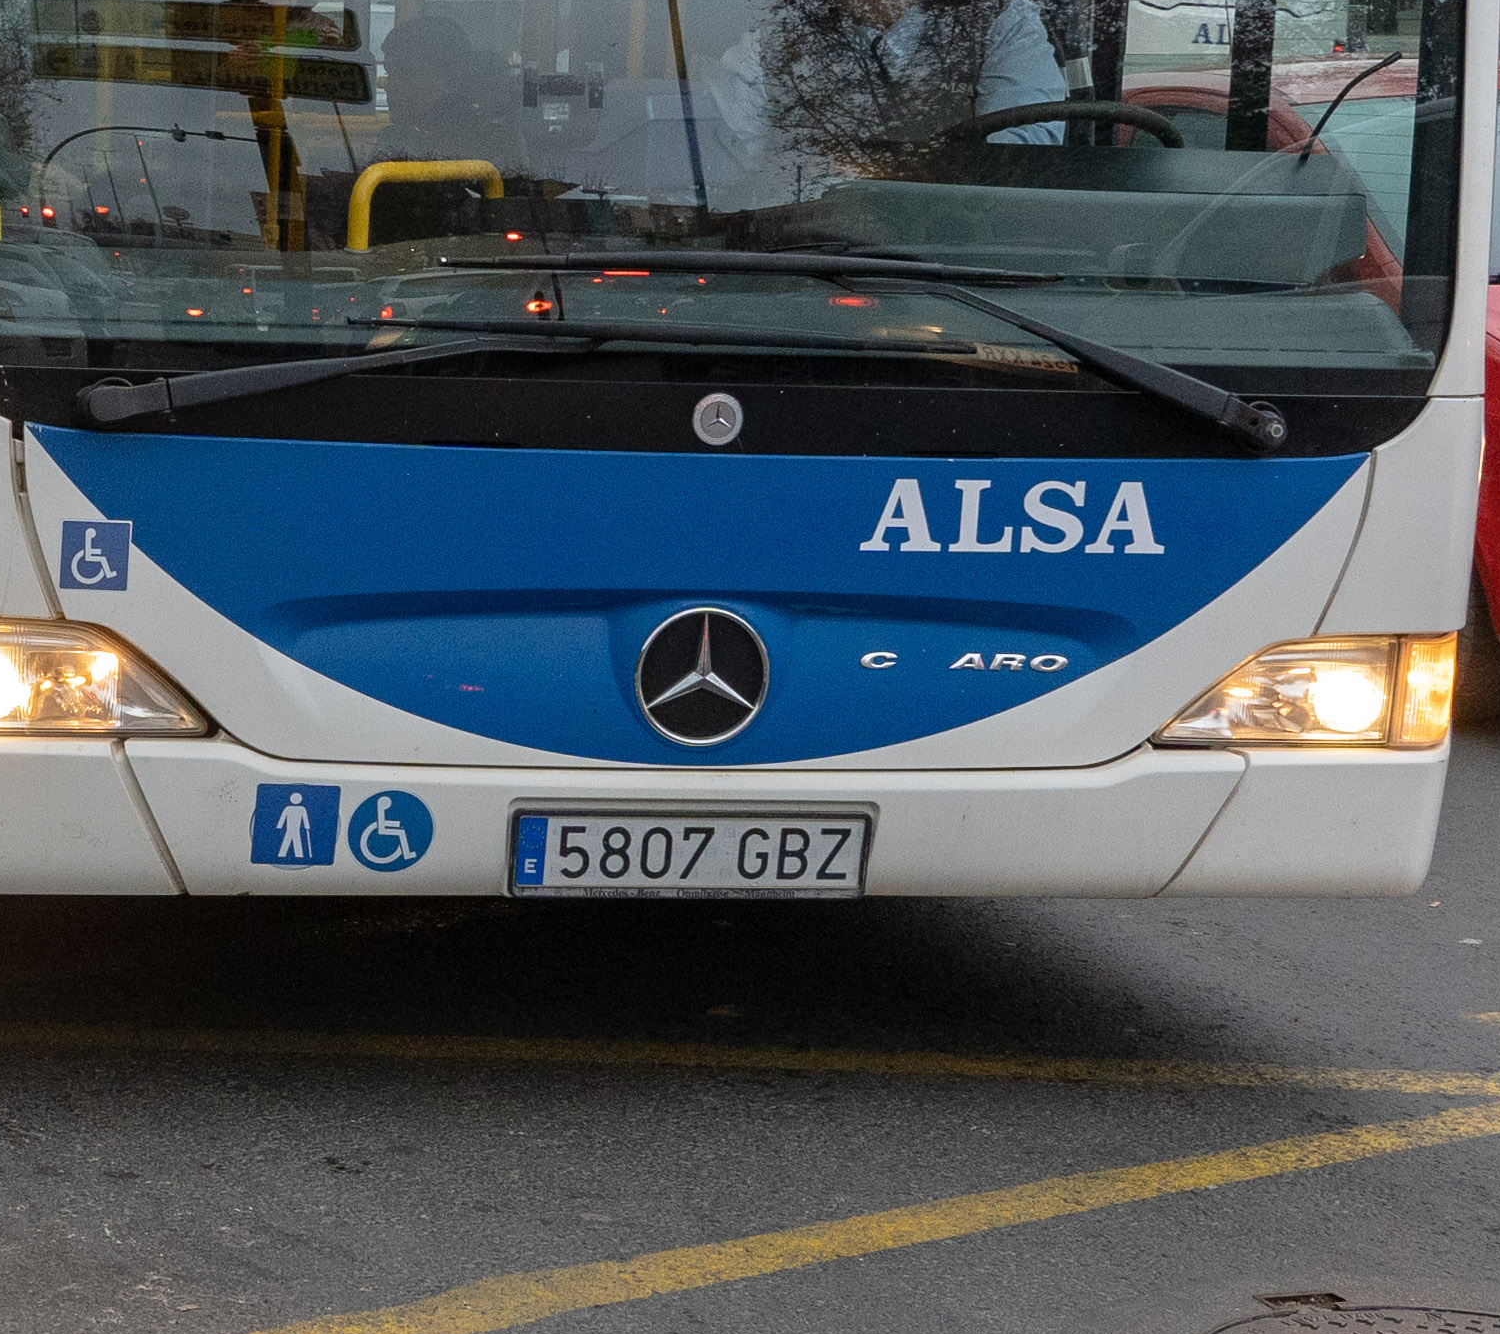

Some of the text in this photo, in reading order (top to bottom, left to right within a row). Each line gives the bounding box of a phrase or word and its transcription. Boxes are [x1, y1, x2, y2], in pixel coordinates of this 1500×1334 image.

[859, 478, 1166, 556] ALSA
[524, 825, 852, 881] E 5807 GBZ
